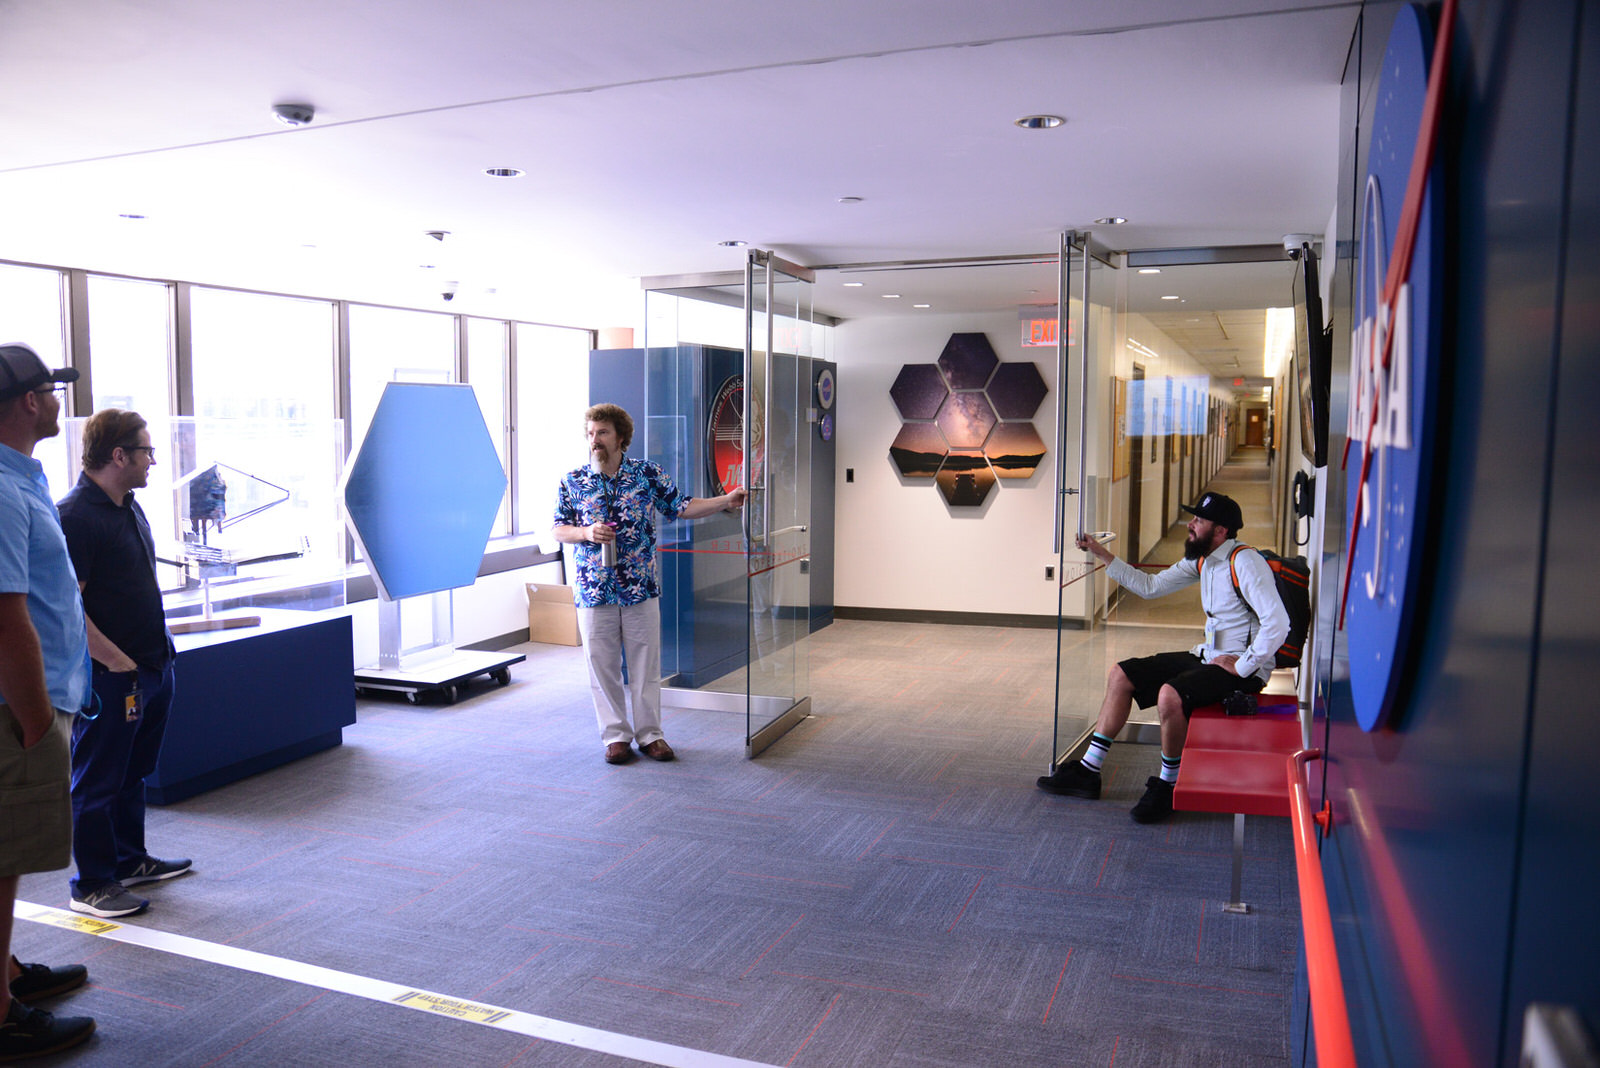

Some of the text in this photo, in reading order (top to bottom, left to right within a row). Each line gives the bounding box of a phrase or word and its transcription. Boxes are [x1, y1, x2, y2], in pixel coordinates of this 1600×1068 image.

[417, 995, 495, 1015] WATCH YOUR STEP
[428, 1004, 467, 1017] CAUTION
